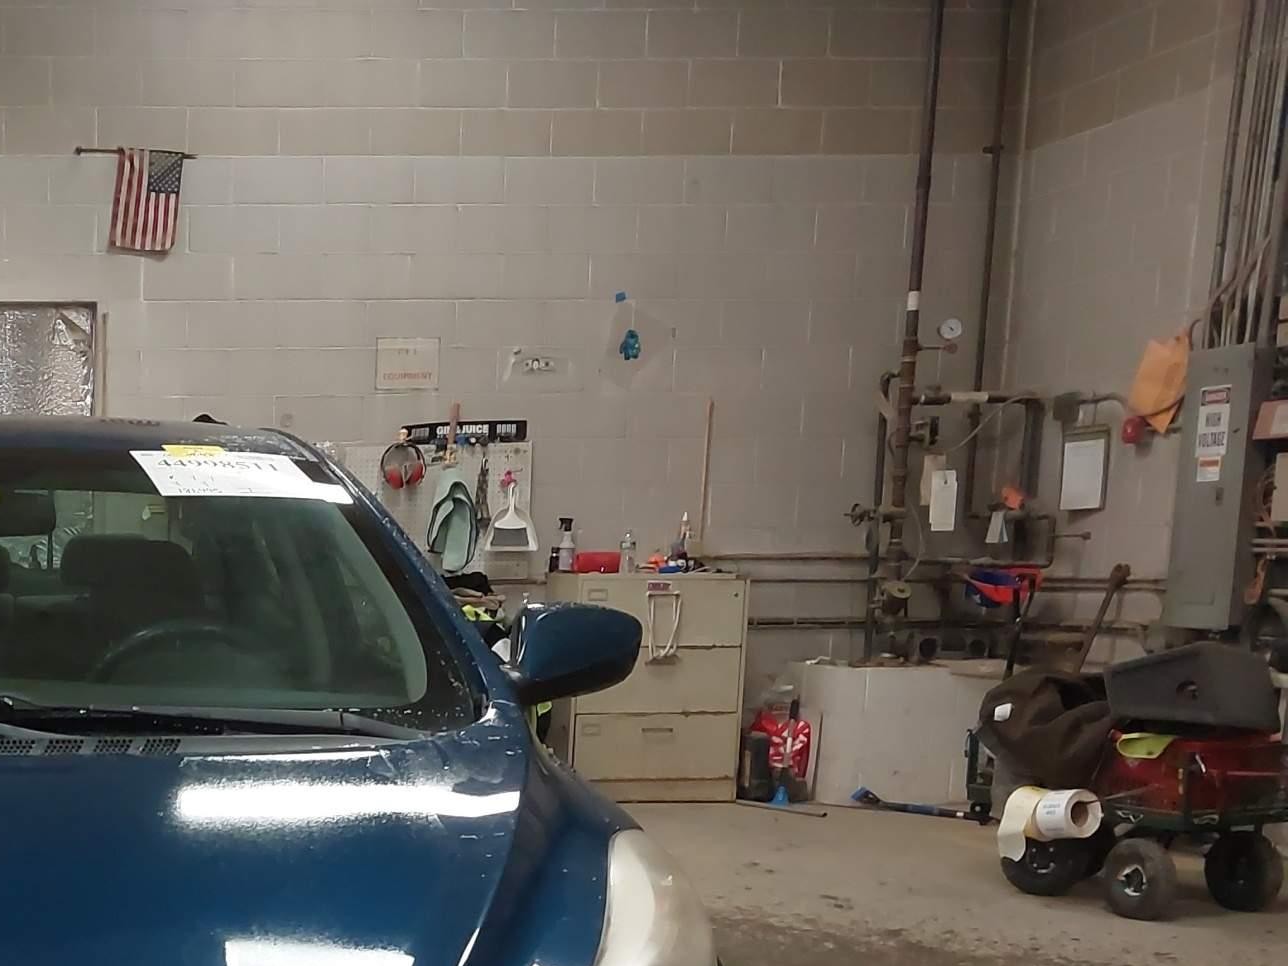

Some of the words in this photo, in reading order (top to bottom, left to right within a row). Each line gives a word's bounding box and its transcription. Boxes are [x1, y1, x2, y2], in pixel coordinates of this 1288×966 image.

[461, 424, 490, 434] JUICE
[1198, 432, 1225, 448] VOLTAGE
[158, 459, 278, 471] 44998511
